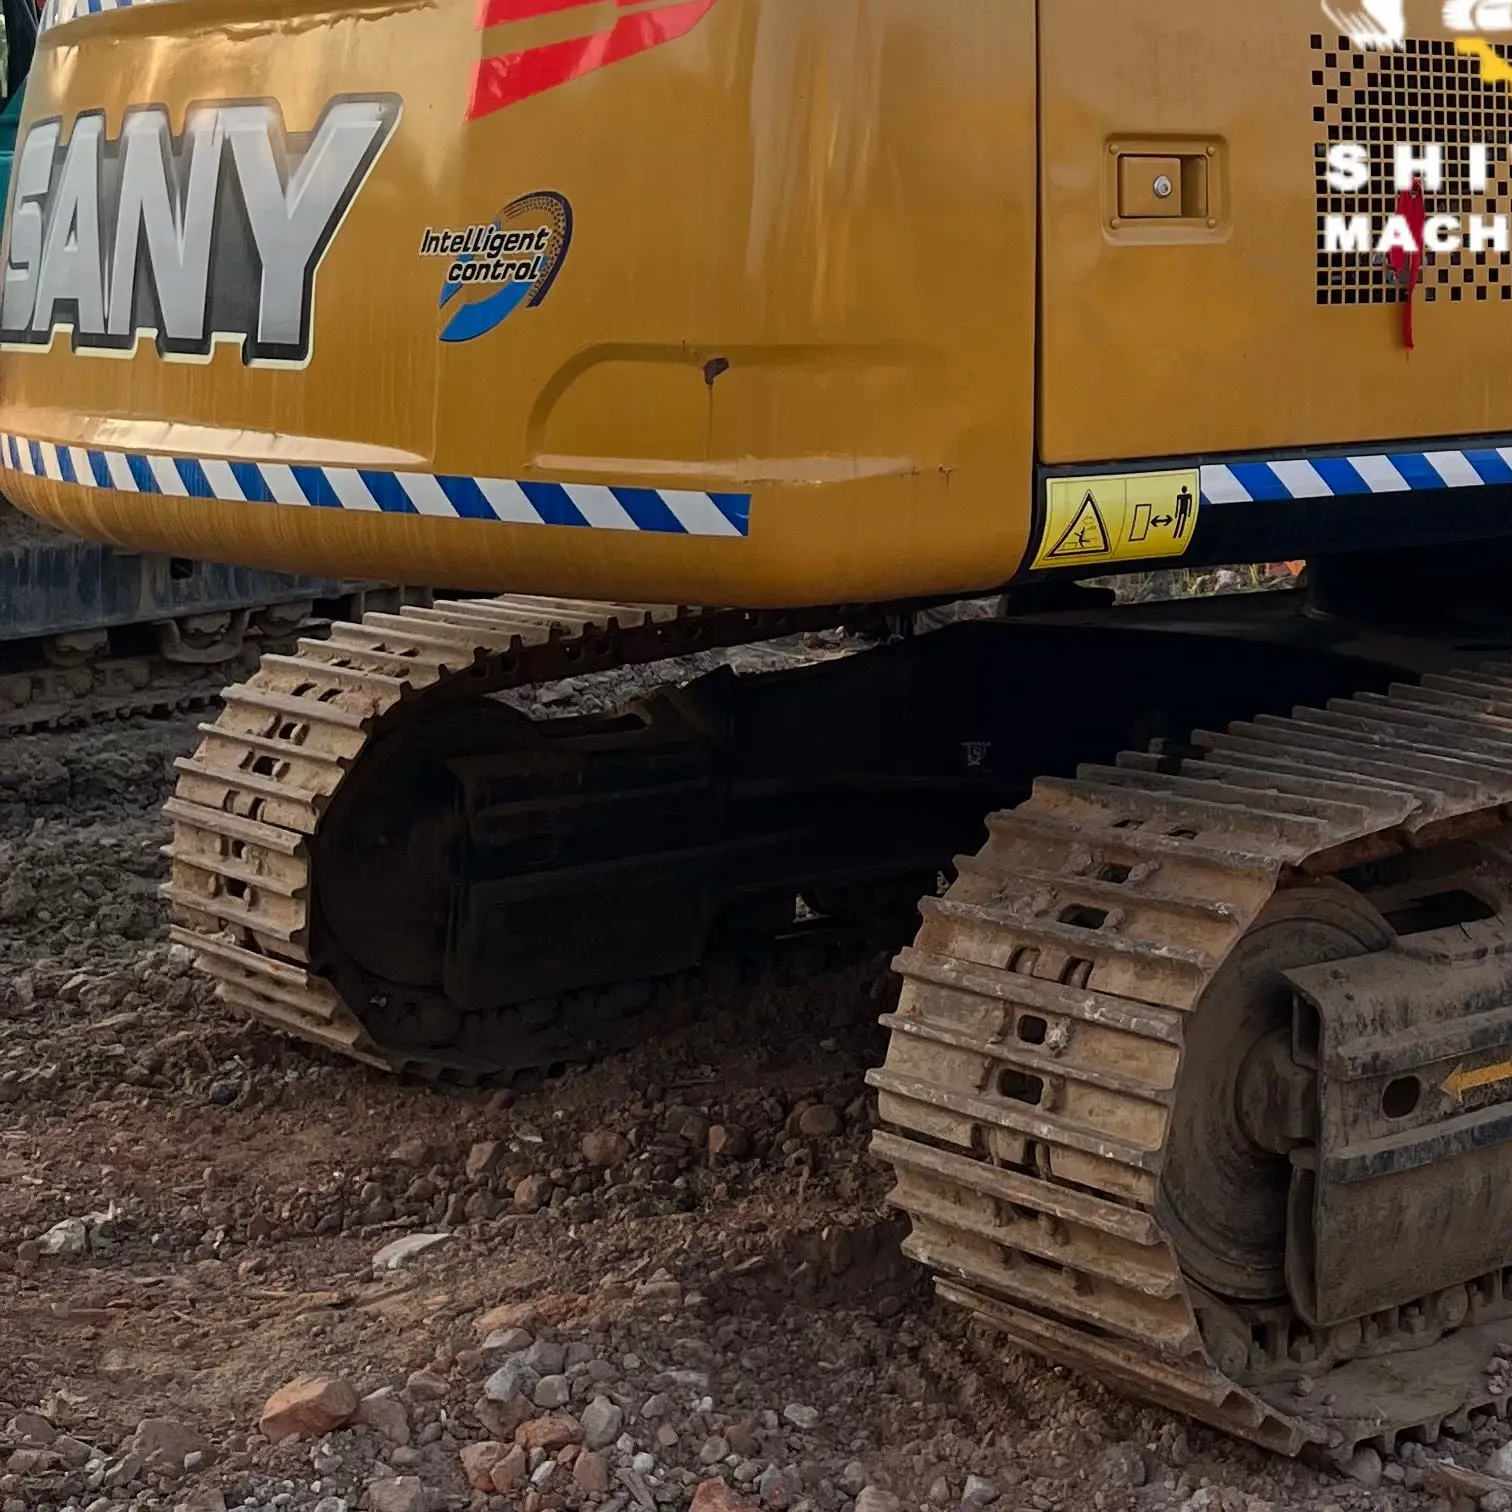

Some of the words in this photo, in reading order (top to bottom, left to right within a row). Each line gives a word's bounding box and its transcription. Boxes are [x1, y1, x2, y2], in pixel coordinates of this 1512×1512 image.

[2, 100, 388, 350] SANY
[420, 226, 550, 259] Intelligent
[448, 255, 542, 281] control
